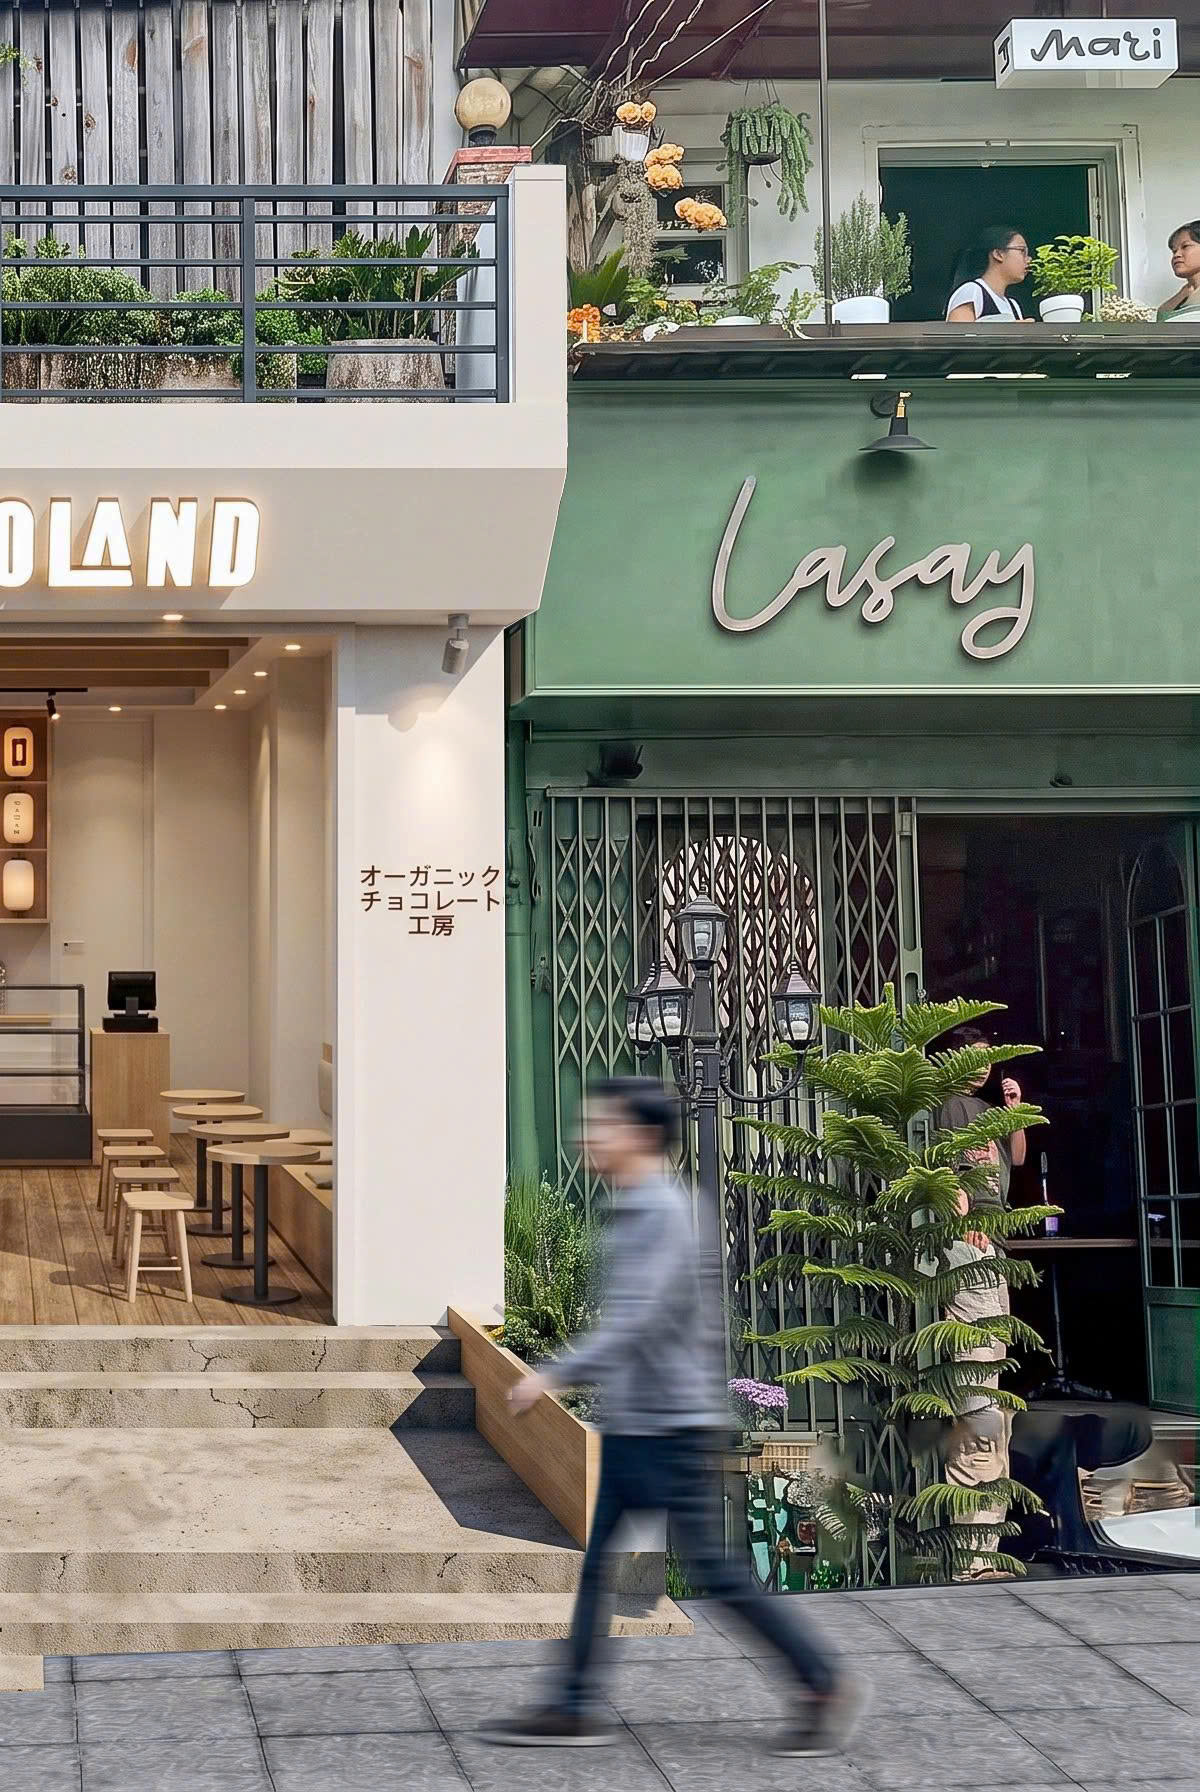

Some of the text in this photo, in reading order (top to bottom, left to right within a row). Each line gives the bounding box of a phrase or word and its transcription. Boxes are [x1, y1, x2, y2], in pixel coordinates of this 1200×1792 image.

[1030, 27, 1161, 62] Mari
[711, 475, 1036, 659] Lasay
[360, 865, 500, 887] オーガニック
[360, 890, 501, 912] チョコレート
[408, 914, 455, 936] 工房
